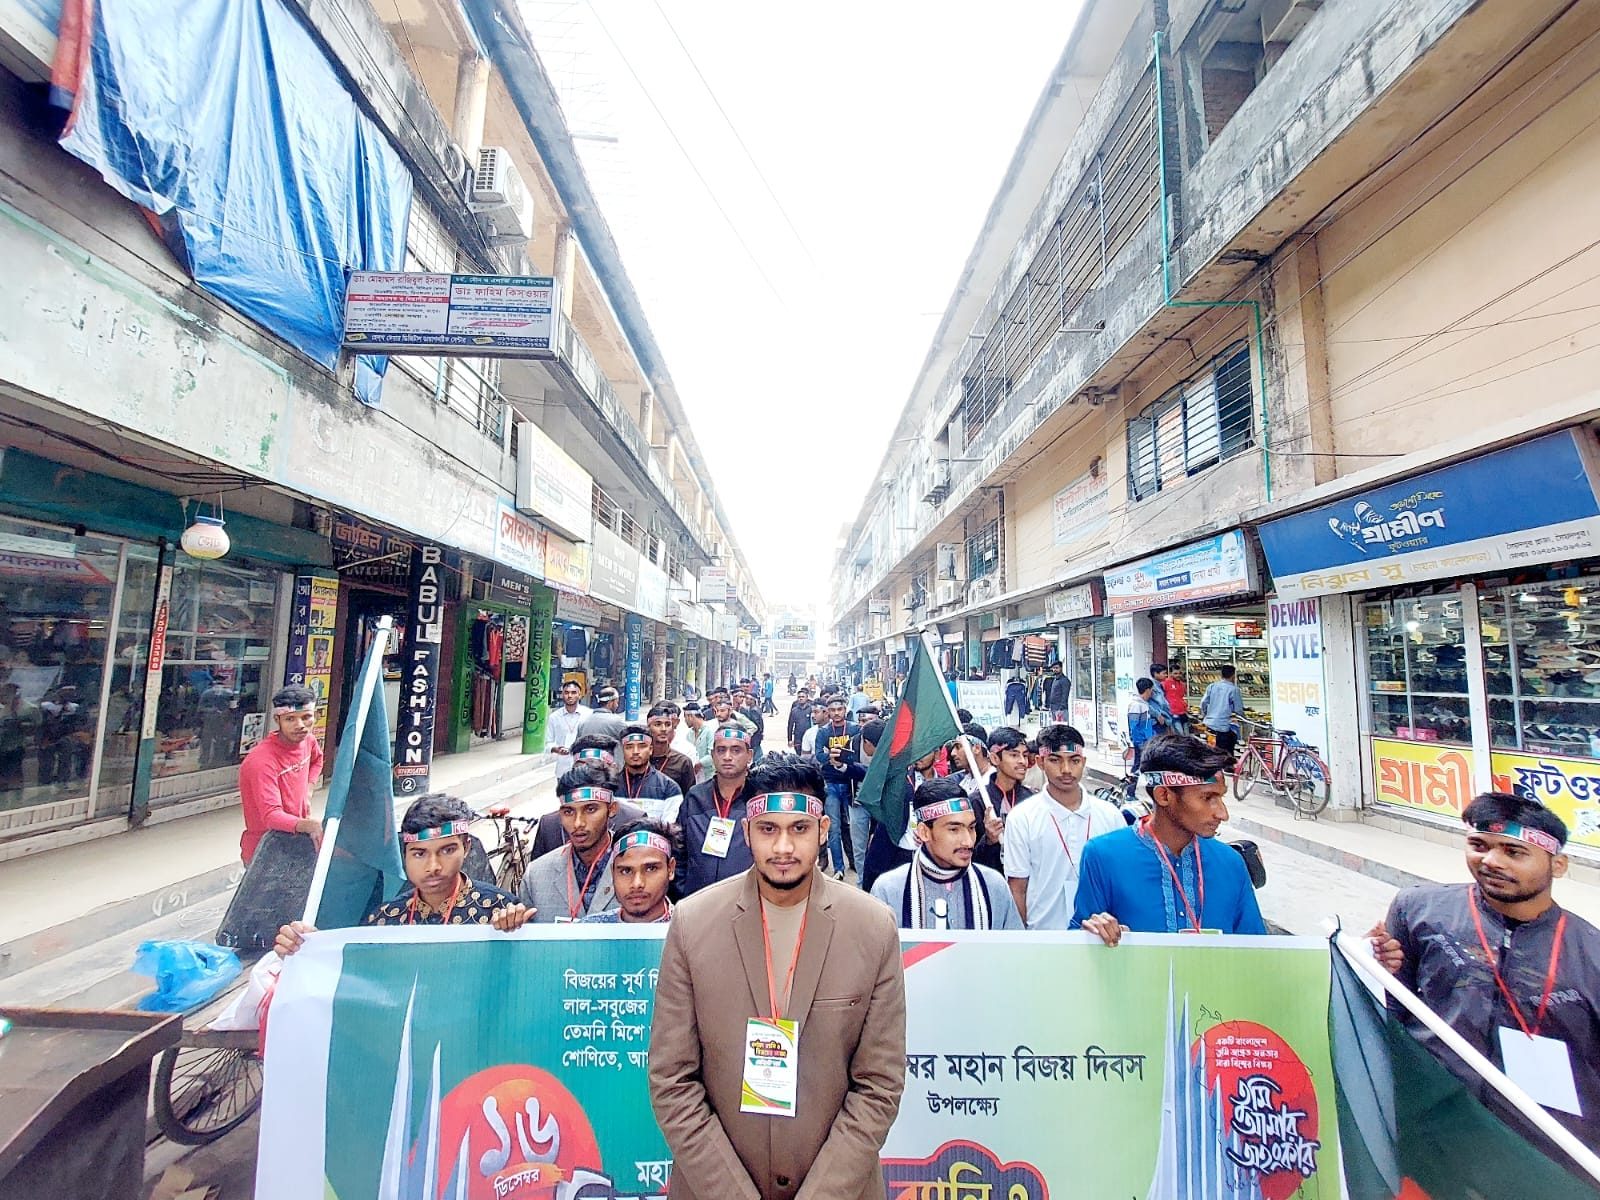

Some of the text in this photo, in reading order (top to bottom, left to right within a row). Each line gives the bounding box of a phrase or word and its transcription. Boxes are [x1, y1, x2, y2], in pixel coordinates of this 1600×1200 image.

[501, 577, 530, 594] MEN'S
[1376, 563, 1407, 581] সু
[416, 546, 442, 643] BABUL
[1271, 600, 1317, 627] DEWAN
[1273, 633, 1319, 659] STYLE
[405, 650, 431, 764] FASHION
[563, 969, 617, 989] বিজয়ের
[621, 968, 645, 994] সূর্য
[563, 999, 648, 1019] লাল-সবুজের
[563, 1019, 645, 1041] তেমনি মিশে
[562, 1046, 622, 1071] শোণিতে,
[944, 1051, 1007, 1085] মহান
[1012, 1045, 1077, 1082] বিজয়
[1083, 1045, 1146, 1082] দিবস
[926, 1090, 1000, 1117] উপলক্ষ্যে
[1230, 1075, 1281, 1122] তুমি
[480, 1095, 560, 1177] ১৬
[634, 1158, 674, 1188] মহা
